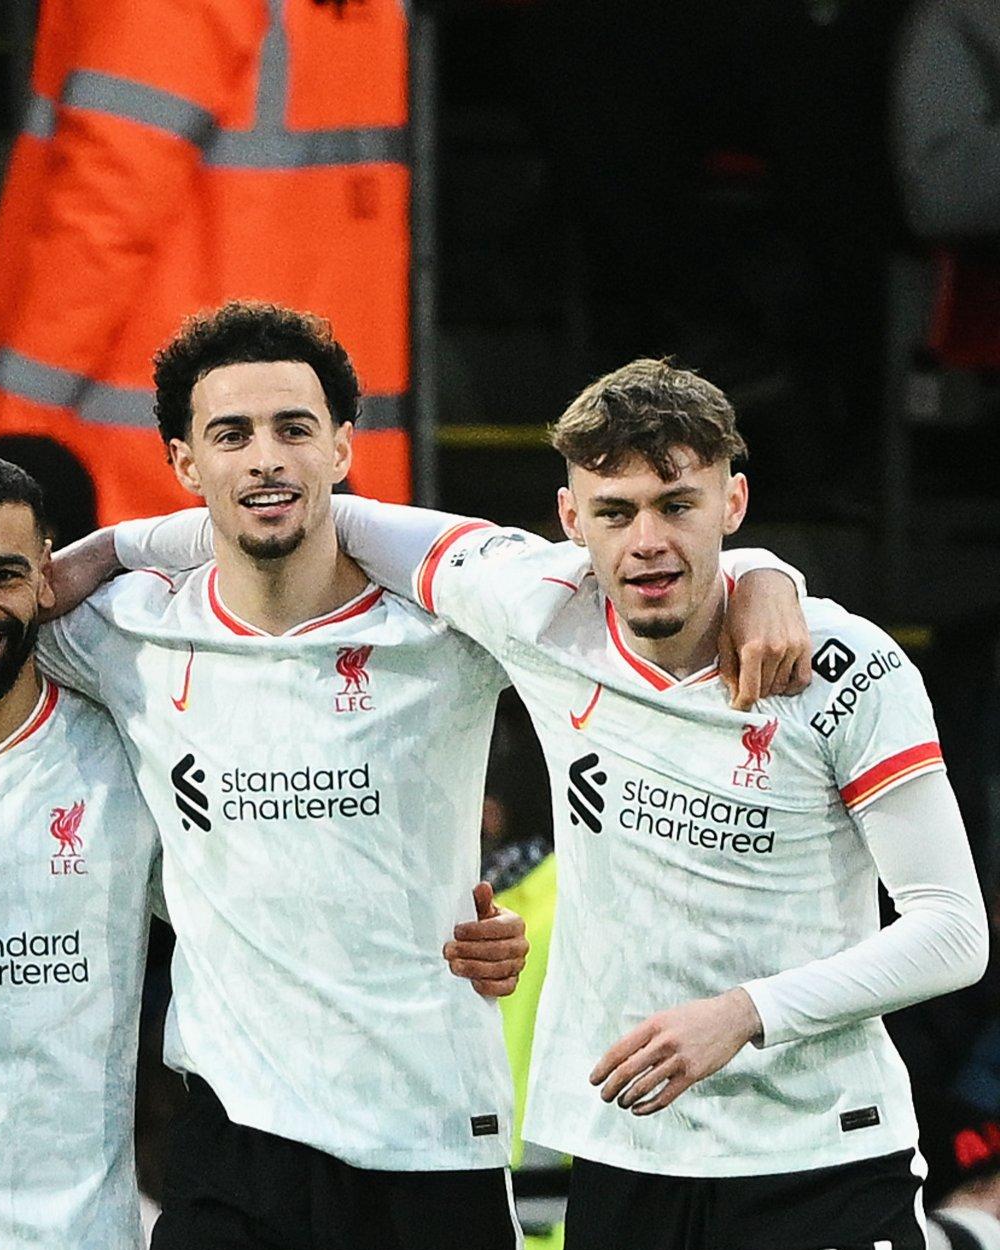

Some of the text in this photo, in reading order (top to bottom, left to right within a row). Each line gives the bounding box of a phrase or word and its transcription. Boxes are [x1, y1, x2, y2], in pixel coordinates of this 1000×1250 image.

[809, 650, 902, 739] Expedia
[221, 762, 370, 793] standard
[222, 790, 380, 822] chartered
[622, 778, 769, 830] standard
[619, 806, 775, 854] chartered
